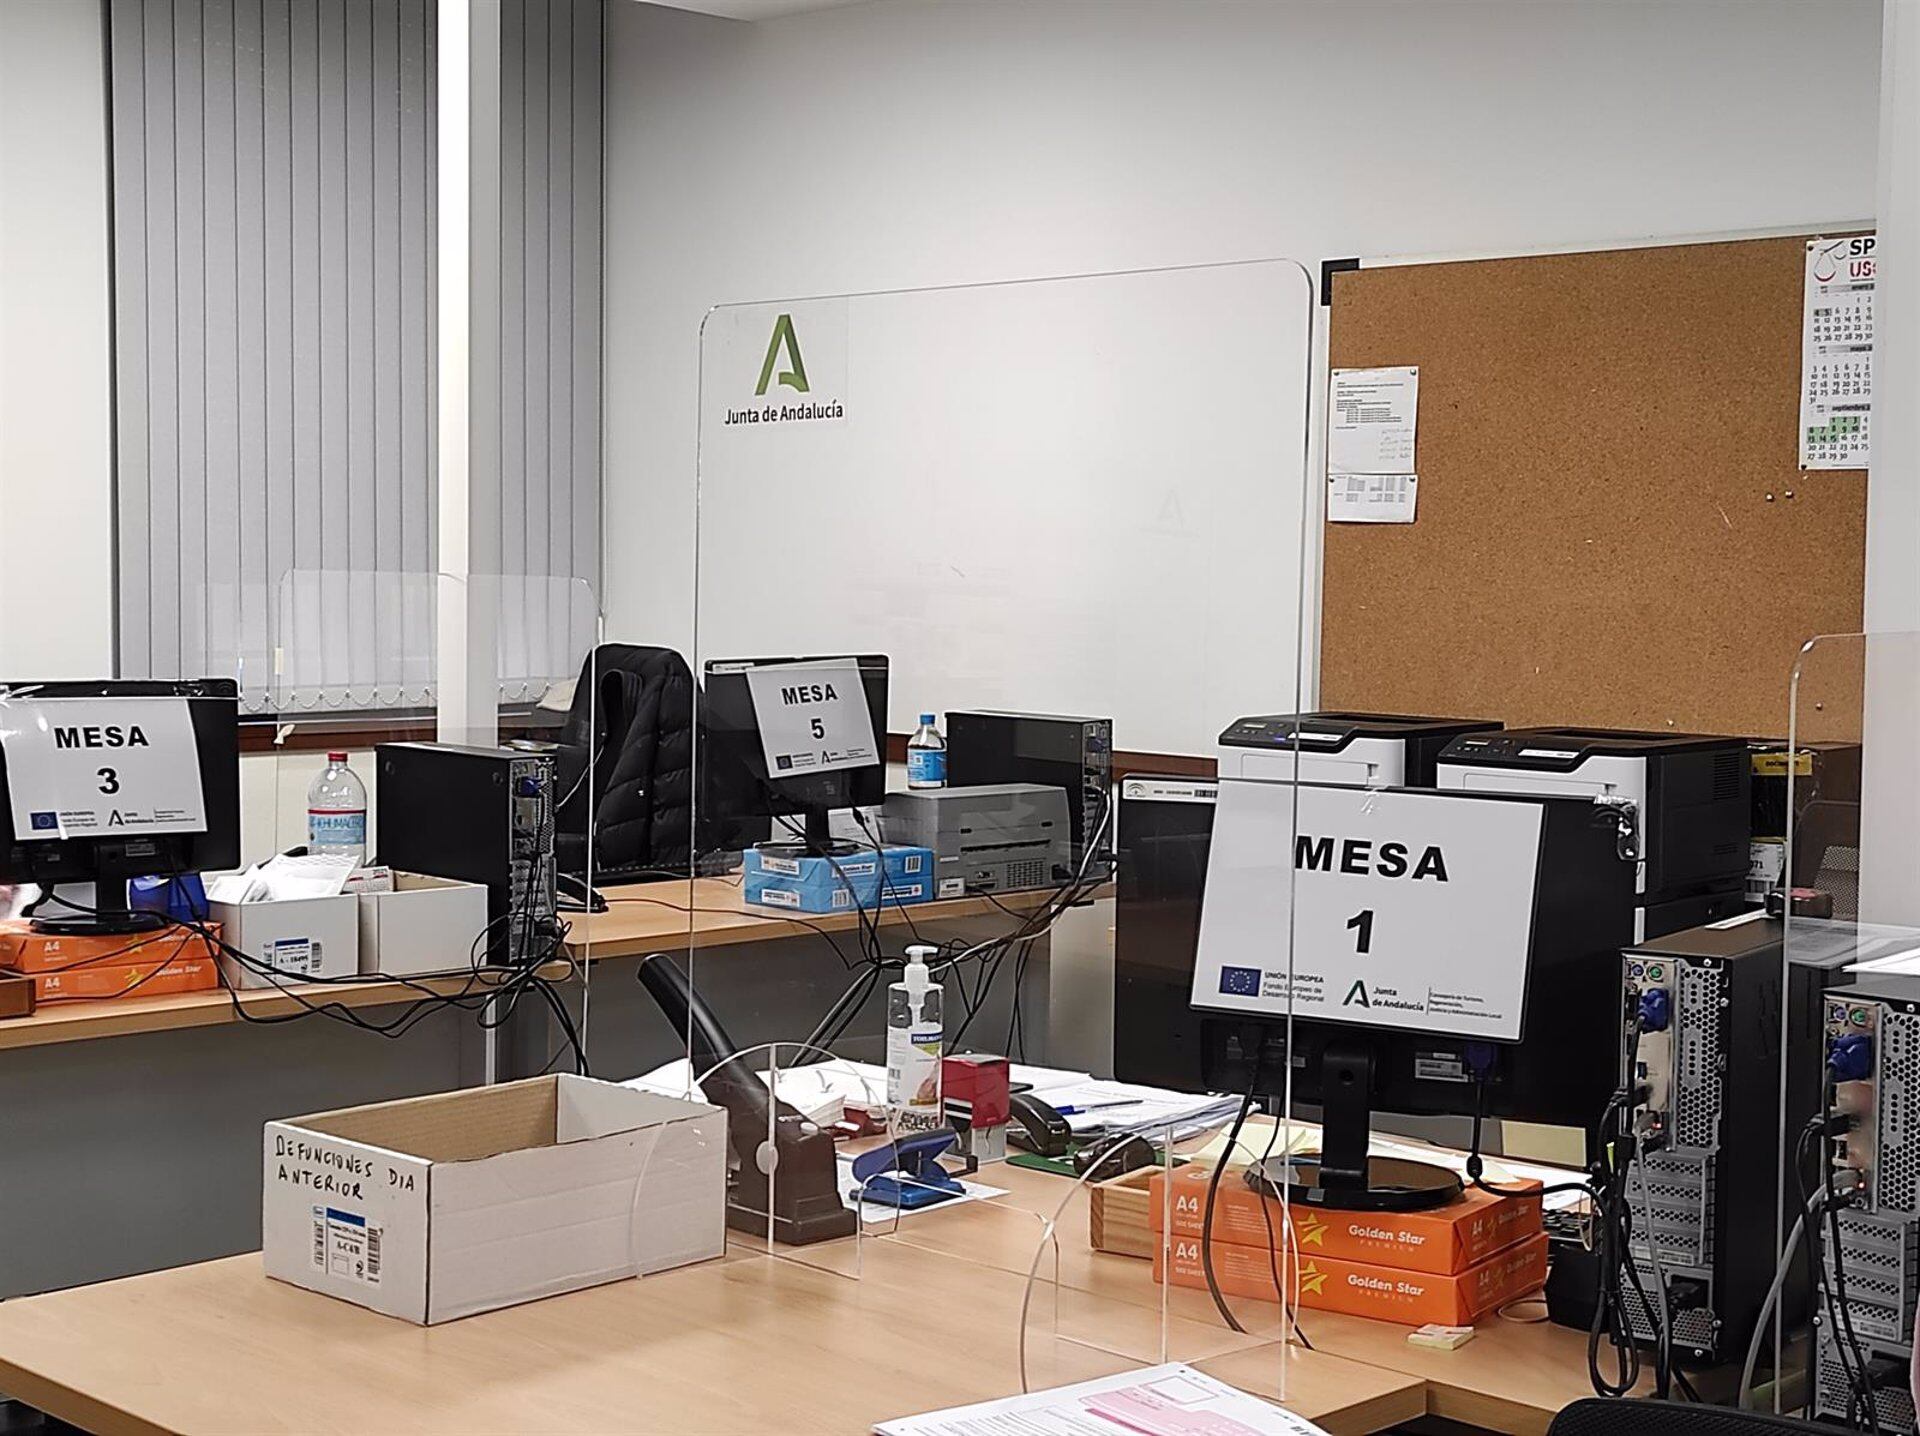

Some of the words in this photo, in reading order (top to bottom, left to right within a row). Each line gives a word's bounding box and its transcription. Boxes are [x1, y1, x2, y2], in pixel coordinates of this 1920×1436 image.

[1850, 261, 1876, 277] US
[725, 408, 759, 425] Junta
[762, 405, 778, 422] de
[780, 398, 843, 421] Andalucía
[781, 683, 838, 705] MESA
[54, 725, 150, 749] MESA
[811, 718, 825, 740] 5
[97, 767, 120, 795] 3
[1294, 834, 1449, 883] MESA
[1346, 909, 1374, 954] 1
[1372, 986, 1398, 997] Junta
[1372, 998, 1383, 1007] de
[1383, 998, 1425, 1012] Andalucía
[275, 1134, 374, 1178] DEFUNCIONES
[388, 1167, 416, 1192] DIA
[277, 1163, 364, 1200] ANTERIOR
[1176, 1195, 1199, 1212] A4
[1348, 1224, 1394, 1242] Golden
[1396, 1230, 1426, 1246] Star
[1175, 1242, 1199, 1260] A4
[1347, 1274, 1393, 1292] Golden
[1396, 1281, 1425, 1297] Star
